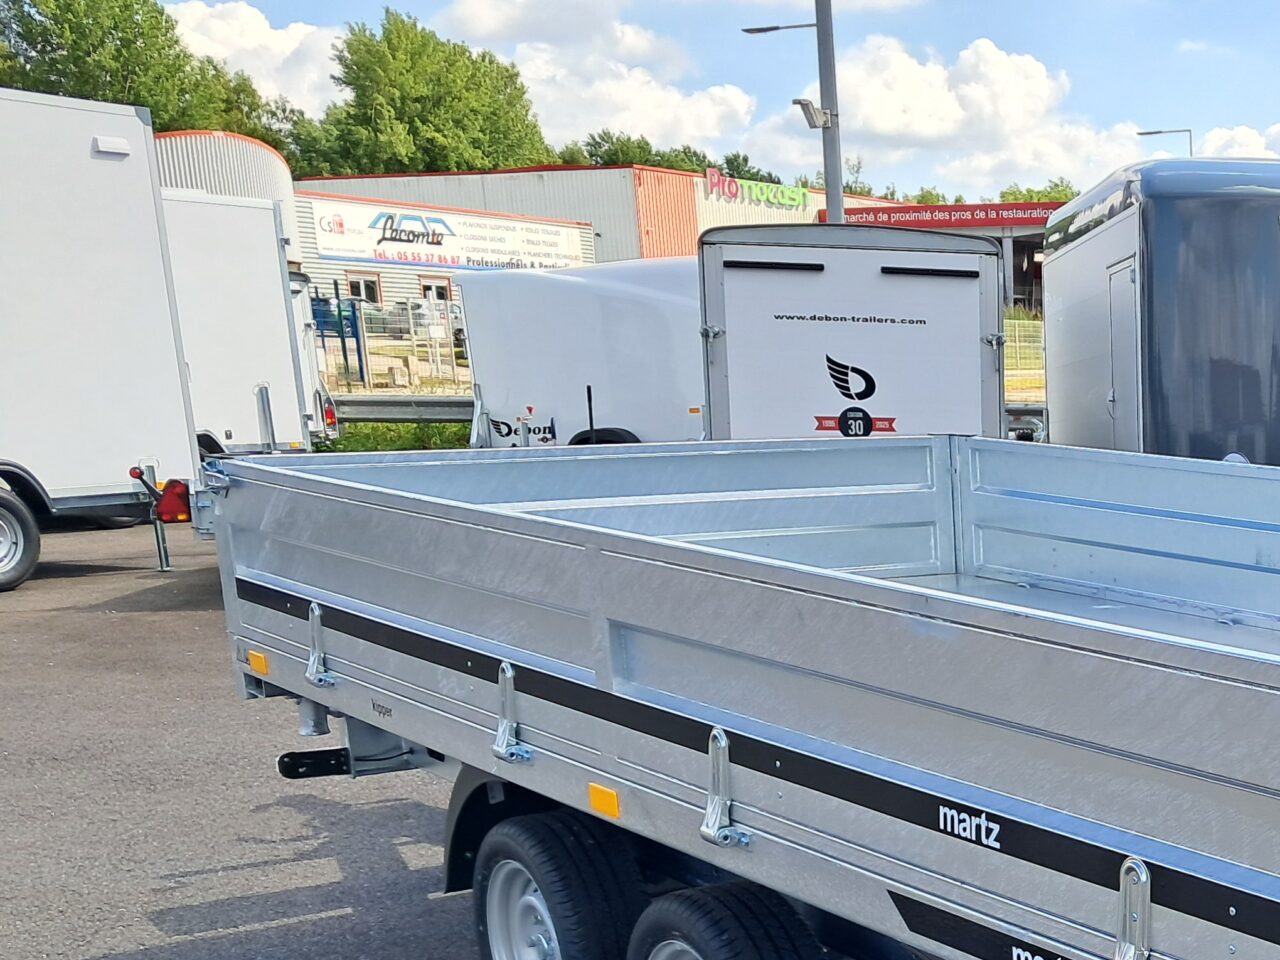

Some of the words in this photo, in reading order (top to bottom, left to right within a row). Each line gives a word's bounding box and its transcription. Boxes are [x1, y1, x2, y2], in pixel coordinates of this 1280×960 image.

[876, 211, 888, 222] de
[891, 209, 932, 223] proximité
[933, 208, 950, 221] des
[951, 208, 972, 222] pros
[975, 206, 986, 219] de
[987, 206, 997, 218] la
[377, 215, 443, 245] Lecomte
[397, 251, 408, 261] 05
[411, 252, 422, 261] 55
[425, 252, 435, 262] 37
[773, 313, 927, 325] www.debon-trailers.com
[847, 419, 864, 435] 30
[371, 698, 393, 718] kipper
[939, 804, 1001, 849] martz
